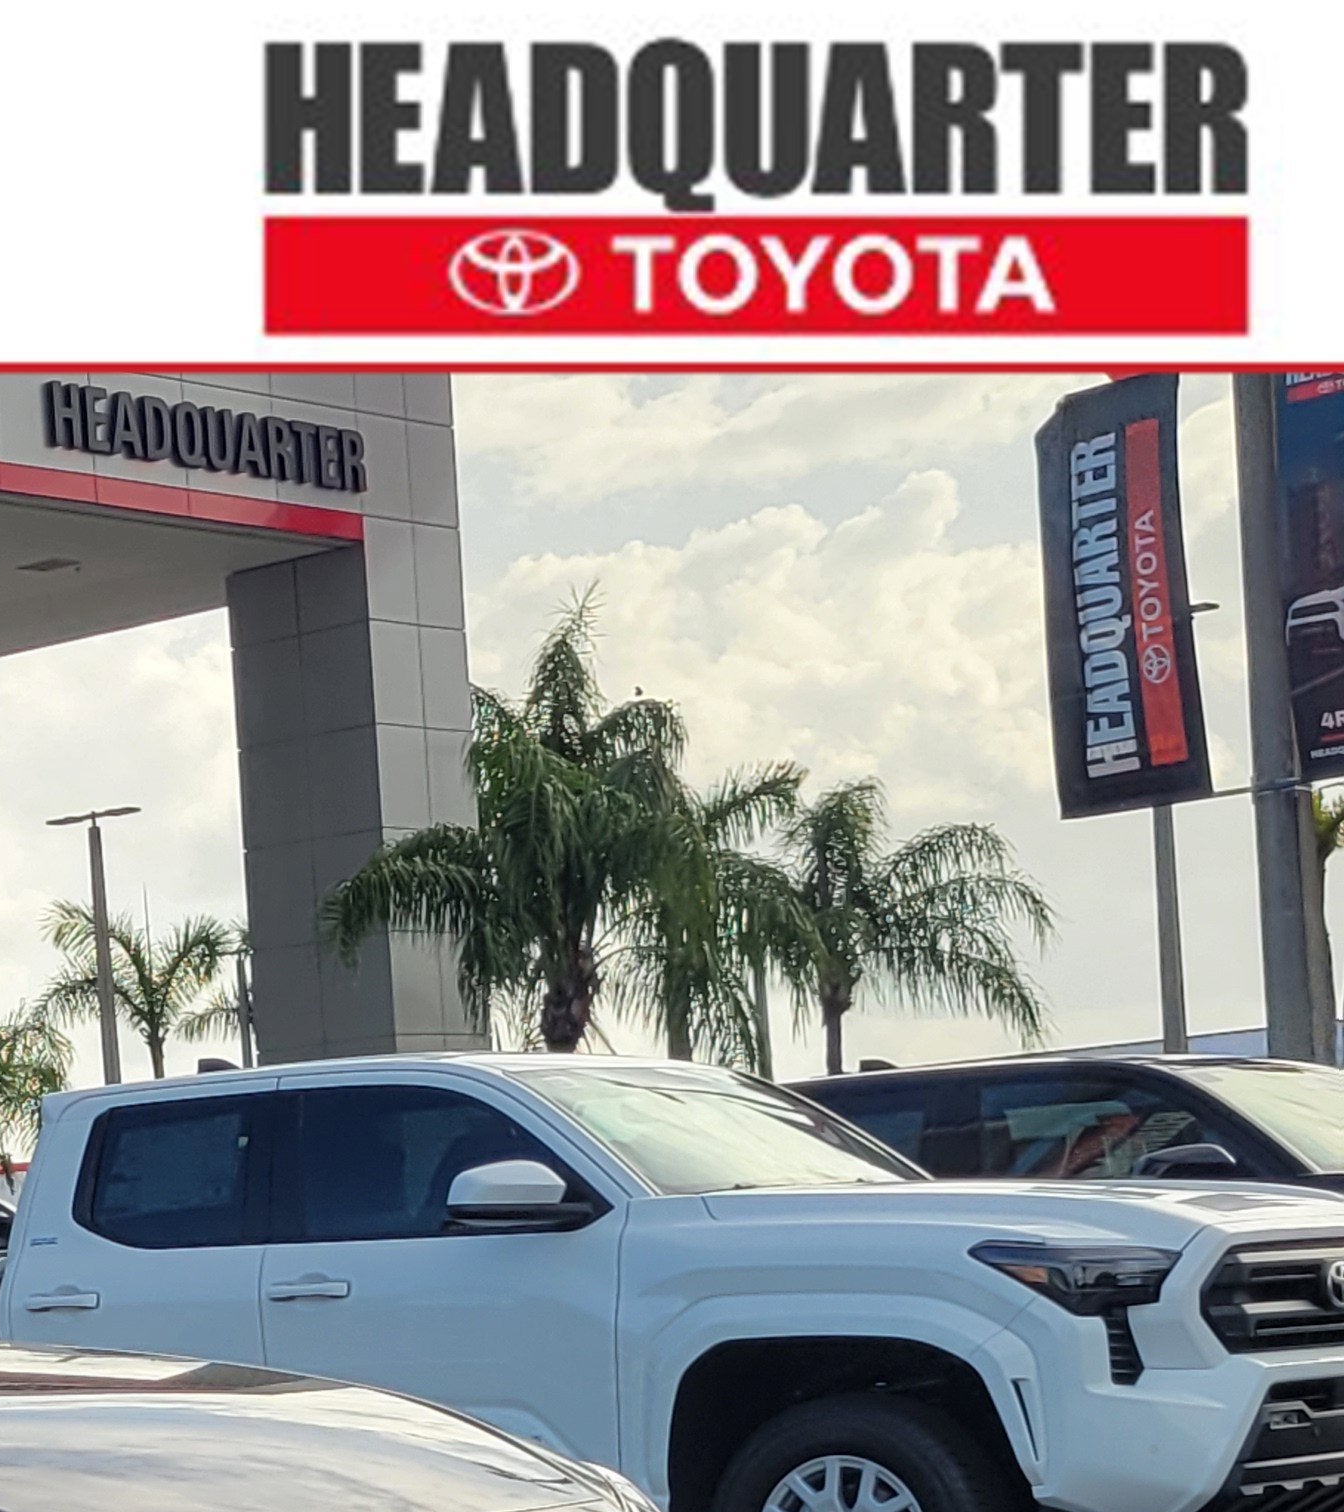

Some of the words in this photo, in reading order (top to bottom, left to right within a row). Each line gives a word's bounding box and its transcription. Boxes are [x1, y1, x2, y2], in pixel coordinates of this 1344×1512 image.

[43, 381, 367, 492] HEADQUARTER
[1069, 432, 1142, 778] HEADQUARTER
[1134, 509, 1172, 641] TOYOTA
